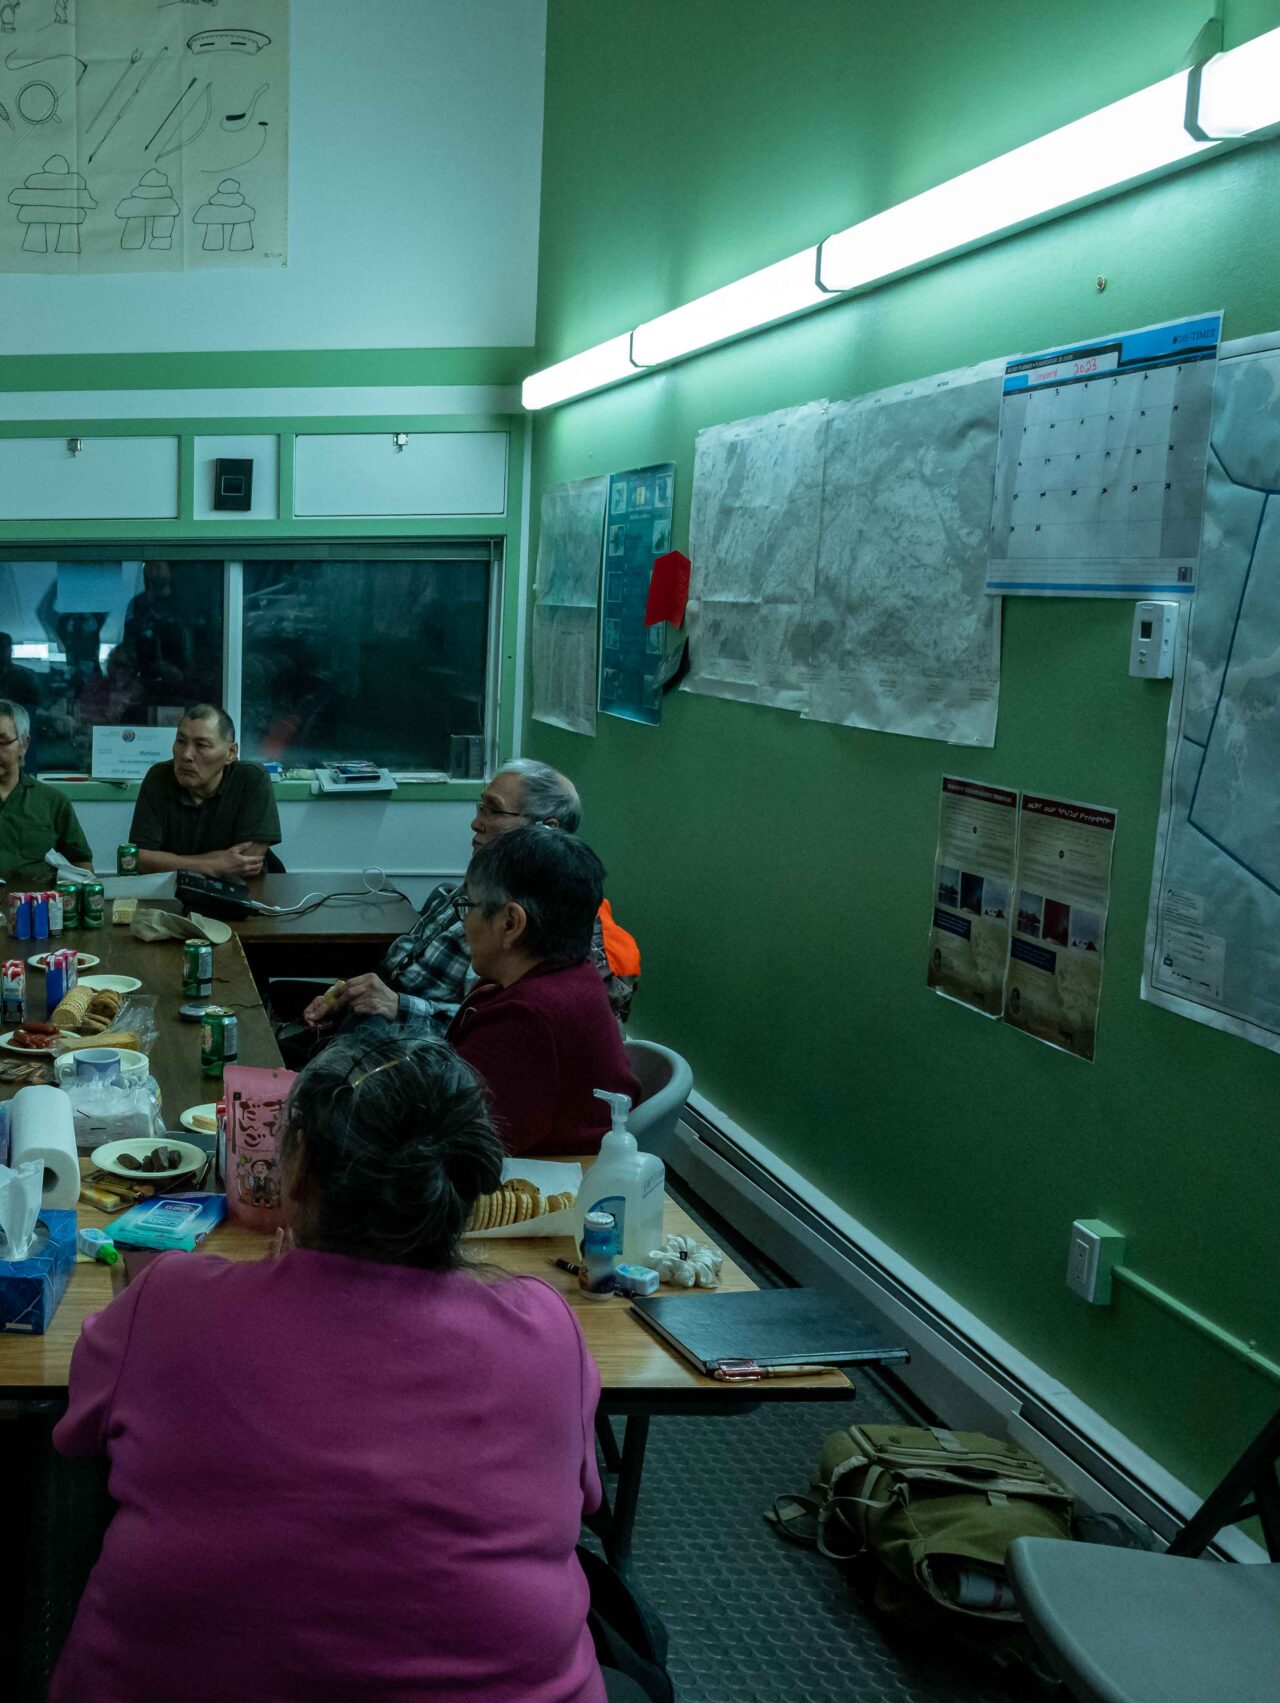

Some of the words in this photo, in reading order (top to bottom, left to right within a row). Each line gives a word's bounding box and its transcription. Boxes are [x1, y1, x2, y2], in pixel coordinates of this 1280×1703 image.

[1073, 357, 1098, 376] 2023
[238, 1100, 266, 1148] だんご
